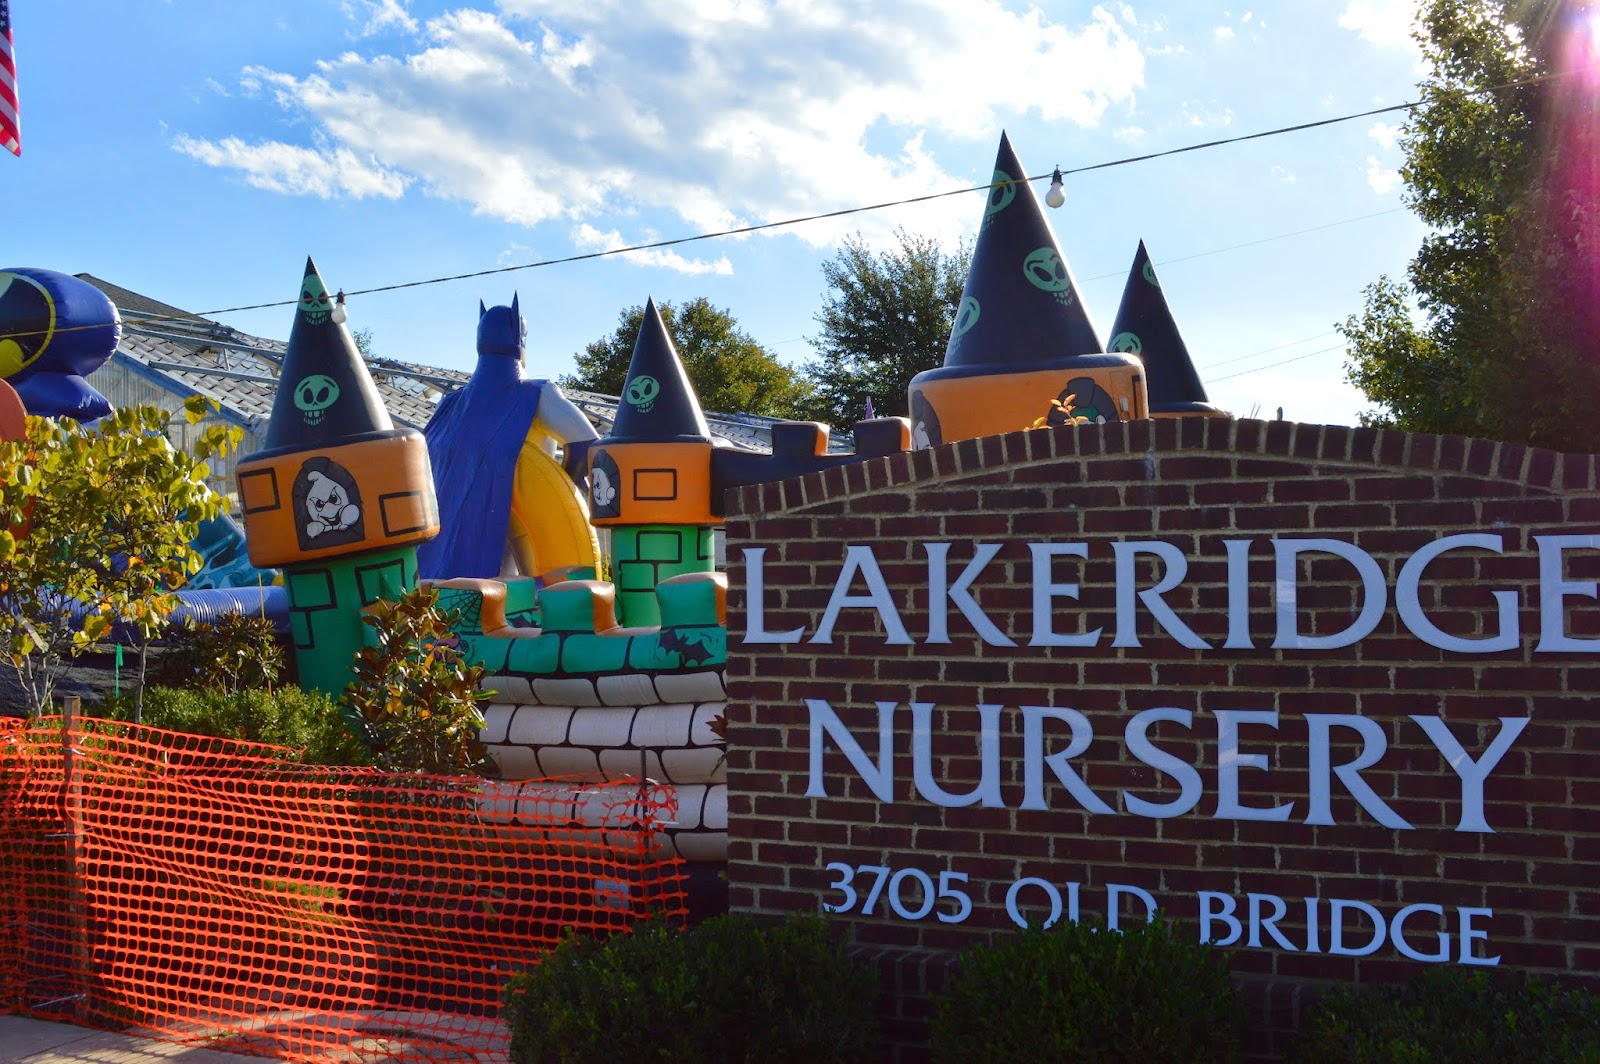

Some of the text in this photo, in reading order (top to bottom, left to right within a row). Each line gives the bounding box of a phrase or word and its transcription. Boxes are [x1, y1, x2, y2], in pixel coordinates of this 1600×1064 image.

[742, 533, 1600, 653] LAKERIDGE
[804, 699, 1532, 833] NURSERY
[823, 862, 973, 923] 3705
[1197, 890, 1501, 966] BRIDGE
